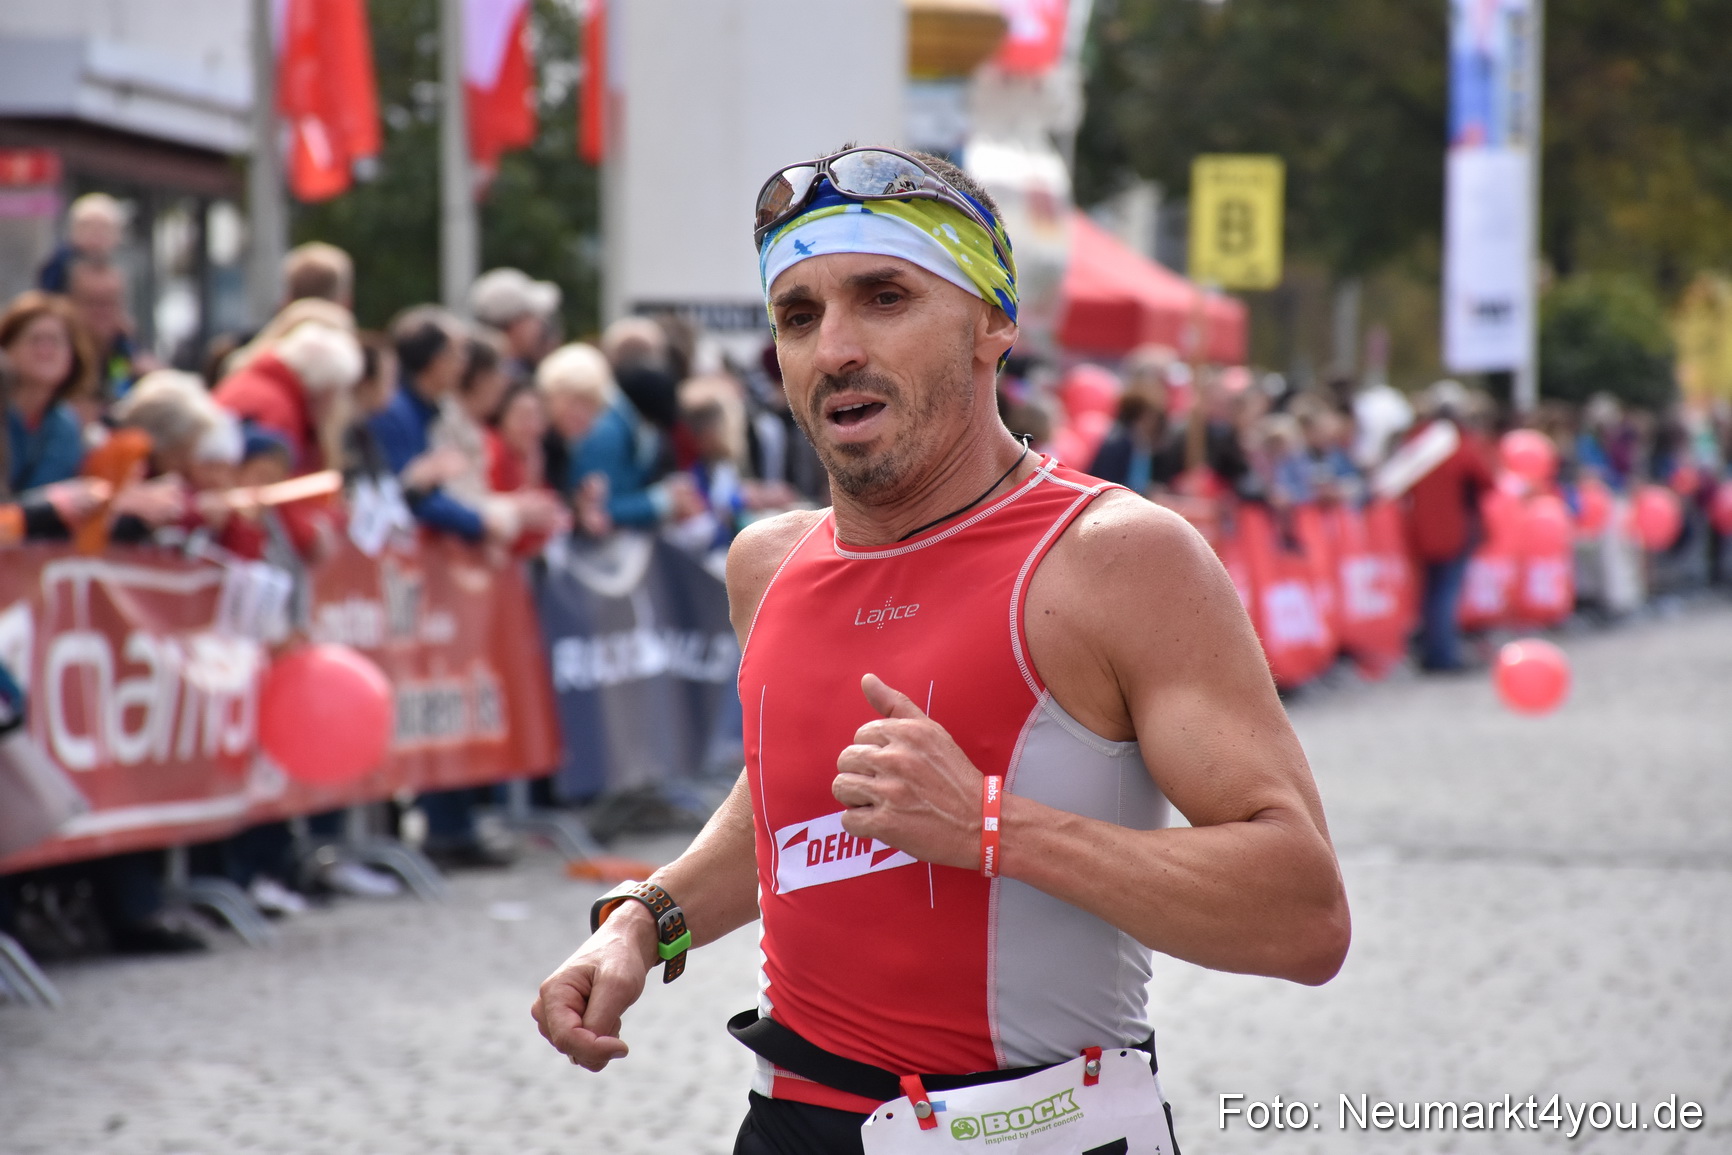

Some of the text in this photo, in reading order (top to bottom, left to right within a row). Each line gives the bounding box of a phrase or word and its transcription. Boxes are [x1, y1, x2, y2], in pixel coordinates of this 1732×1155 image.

[854, 603, 920, 626] Lance
[806, 831, 873, 868] DEHN
[981, 1088, 1080, 1137] BOCK
[984, 1112, 1085, 1145] inspired by smart concepts
